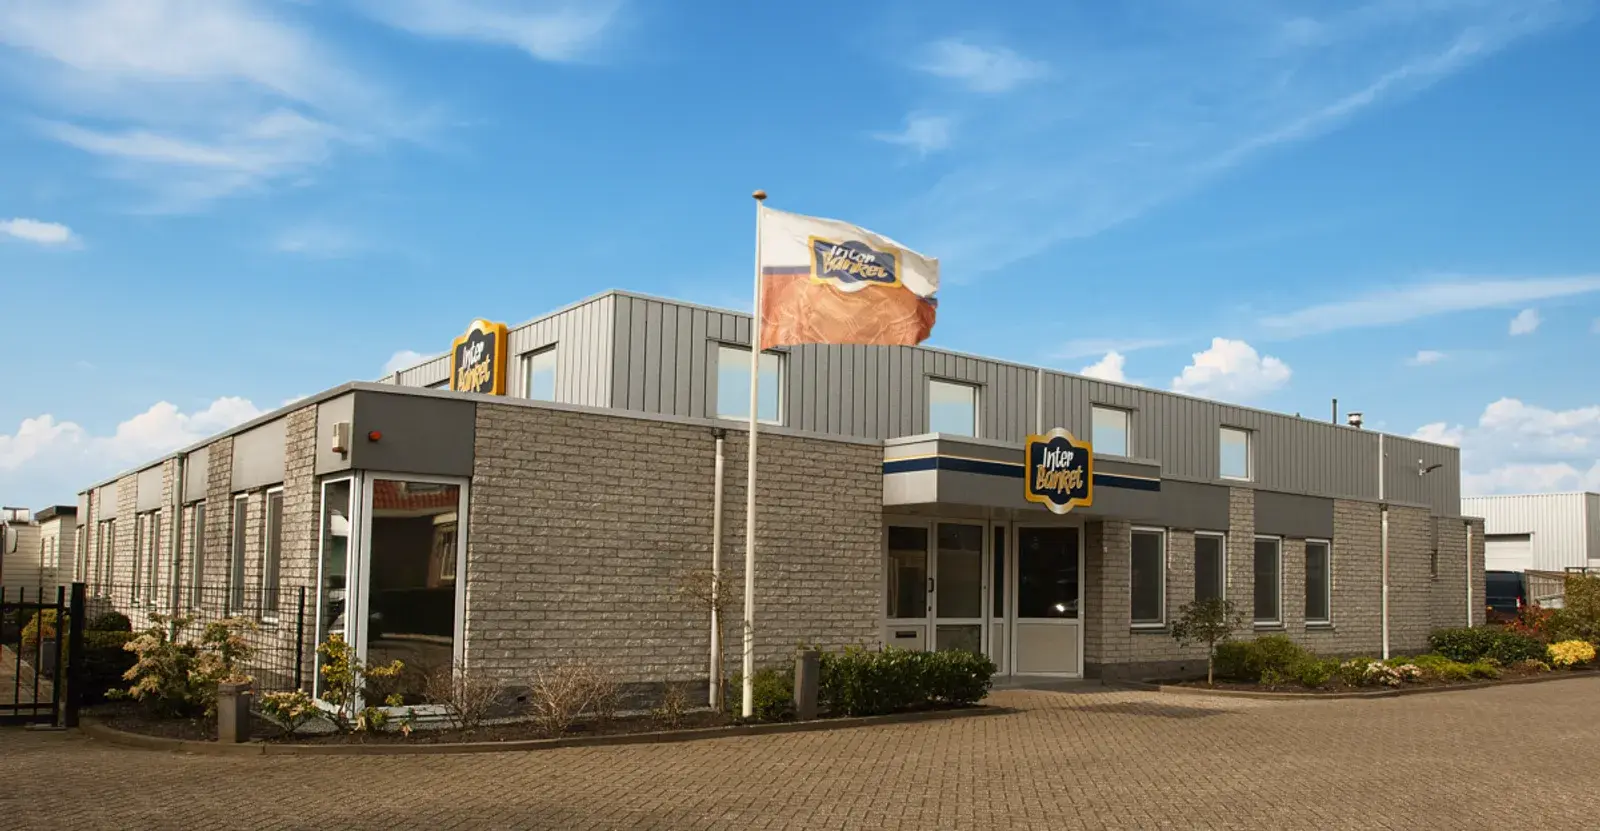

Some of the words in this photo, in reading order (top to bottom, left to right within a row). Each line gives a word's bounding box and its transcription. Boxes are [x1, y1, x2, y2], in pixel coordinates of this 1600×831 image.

[822, 251, 888, 278] Banket
[830, 245, 876, 263] Inter
[462, 341, 485, 370] Inter
[1043, 446, 1074, 472] Inter
[1035, 464, 1084, 494] Banket
